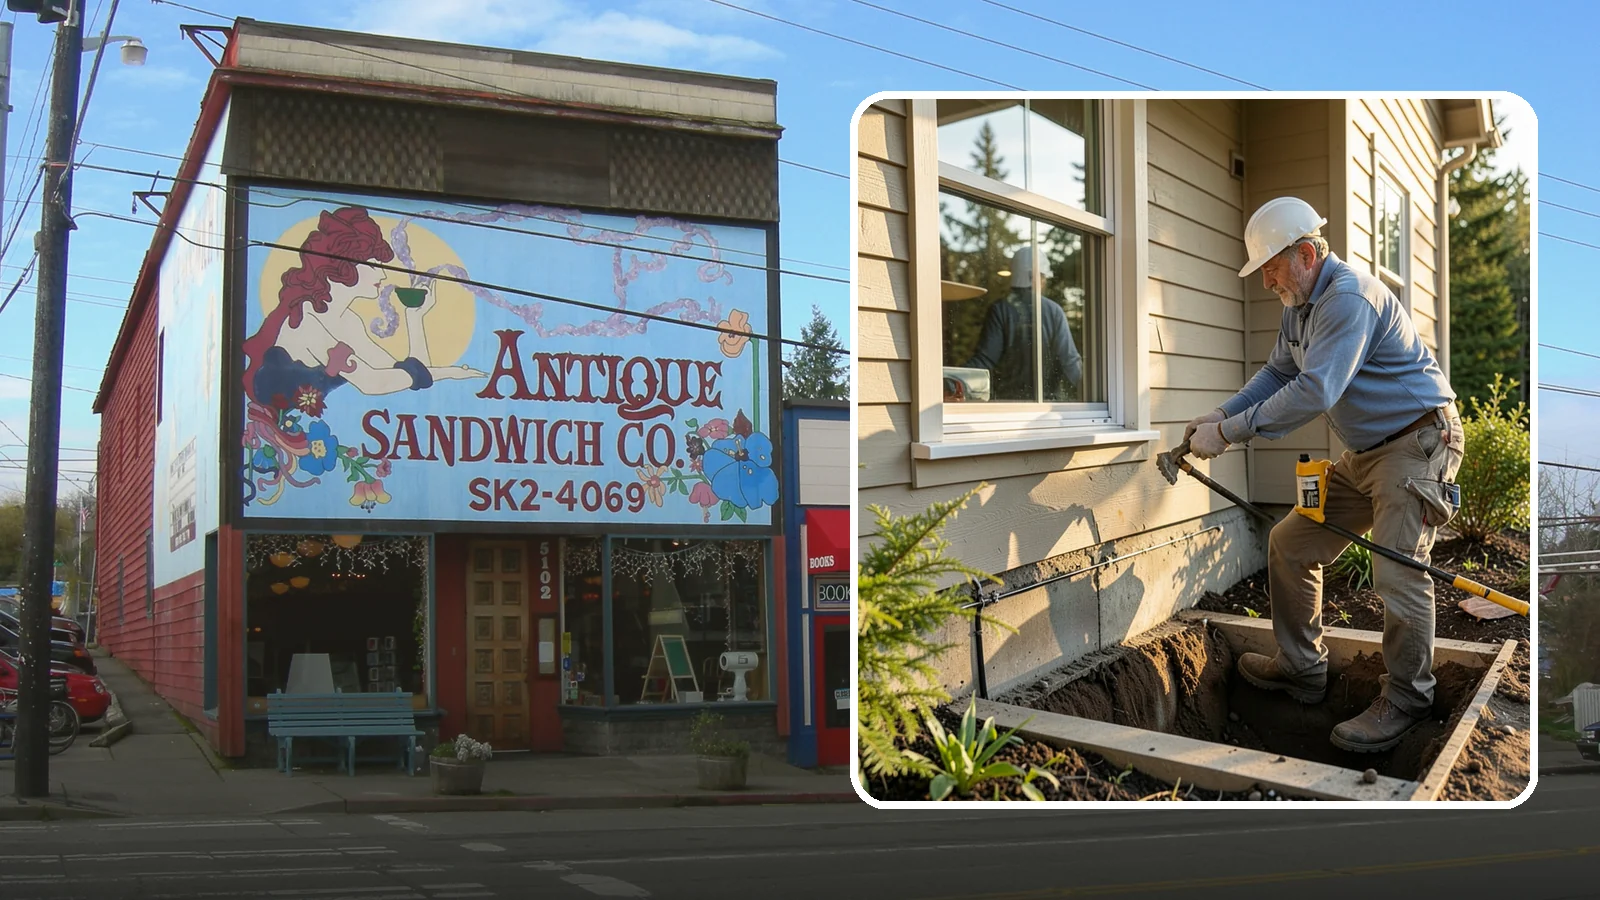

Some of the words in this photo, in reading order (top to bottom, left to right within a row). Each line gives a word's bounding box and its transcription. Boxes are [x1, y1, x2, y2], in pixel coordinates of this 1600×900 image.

[476, 329, 722, 420] ANTIQUE
[362, 408, 604, 468] SANDWICH
[617, 423, 684, 468] CO.
[468, 477, 645, 513] SK2-4069
[540, 542, 552, 599] 5102
[809, 555, 834, 569] BOOKS
